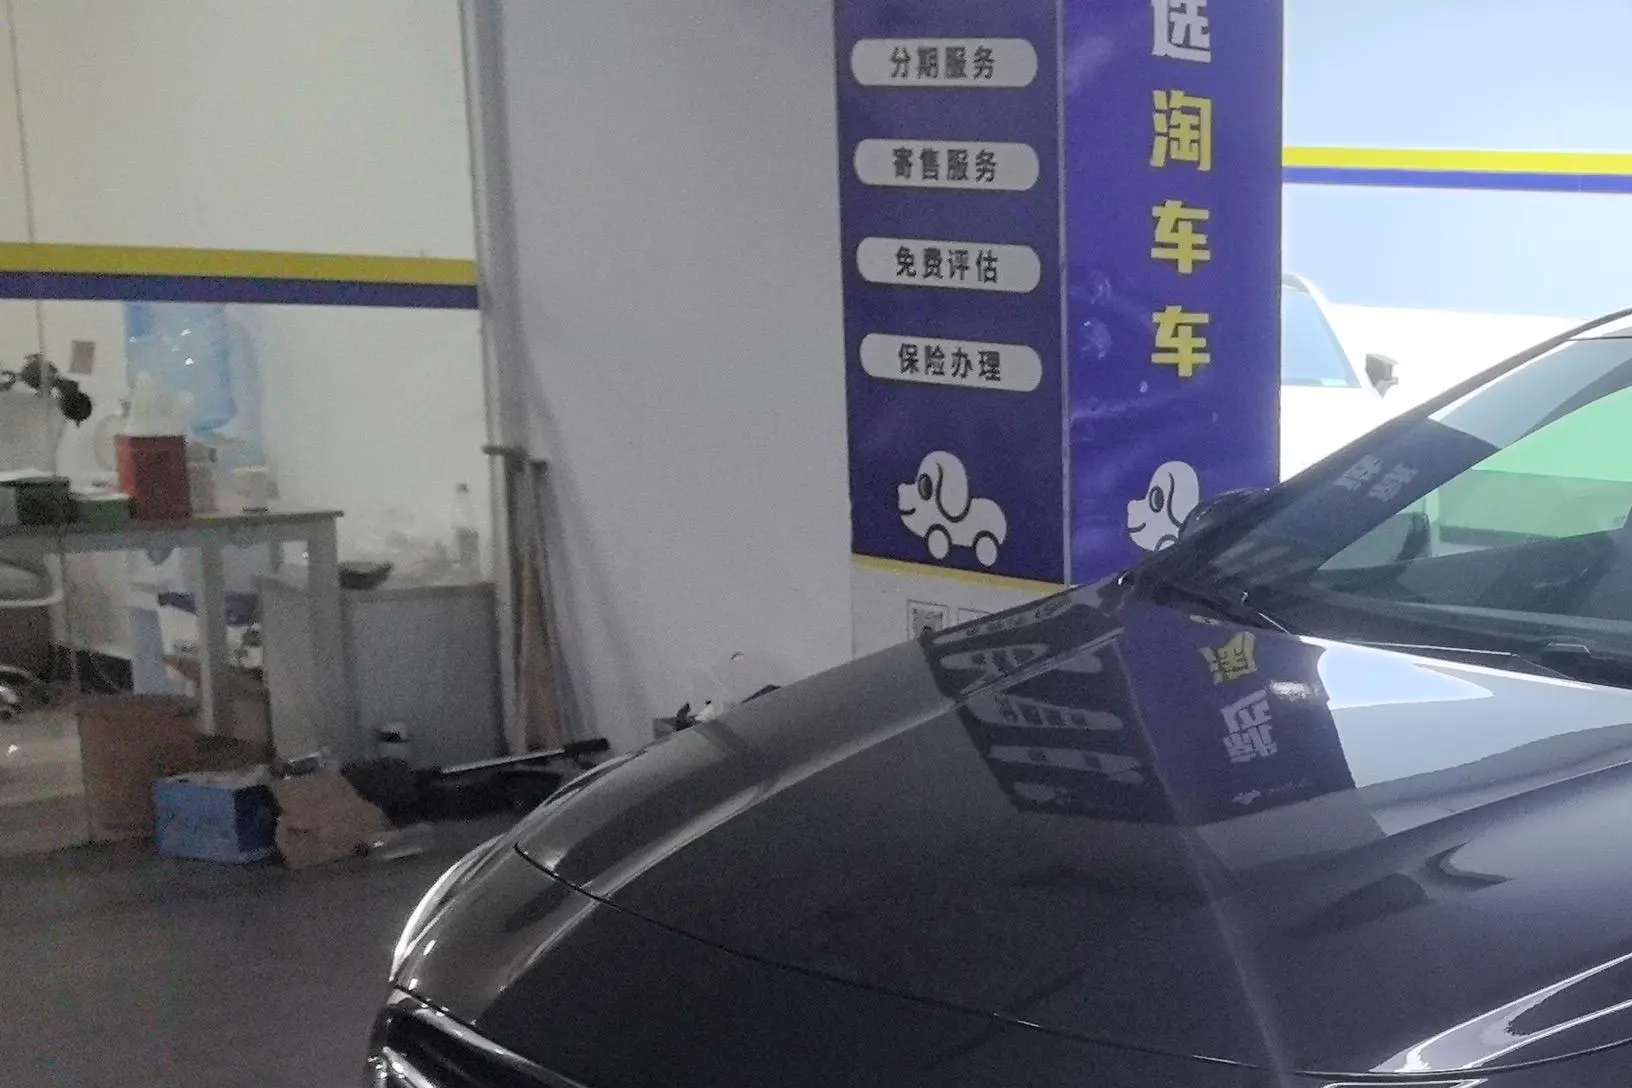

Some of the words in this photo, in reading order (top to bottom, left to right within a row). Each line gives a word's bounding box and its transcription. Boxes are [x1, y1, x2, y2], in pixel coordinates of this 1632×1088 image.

[889, 45, 995, 79] 分期服务
[892, 146, 997, 182] 寄售服务
[895, 246, 998, 283] 免费评估
[898, 343, 1001, 381] 保险办理
